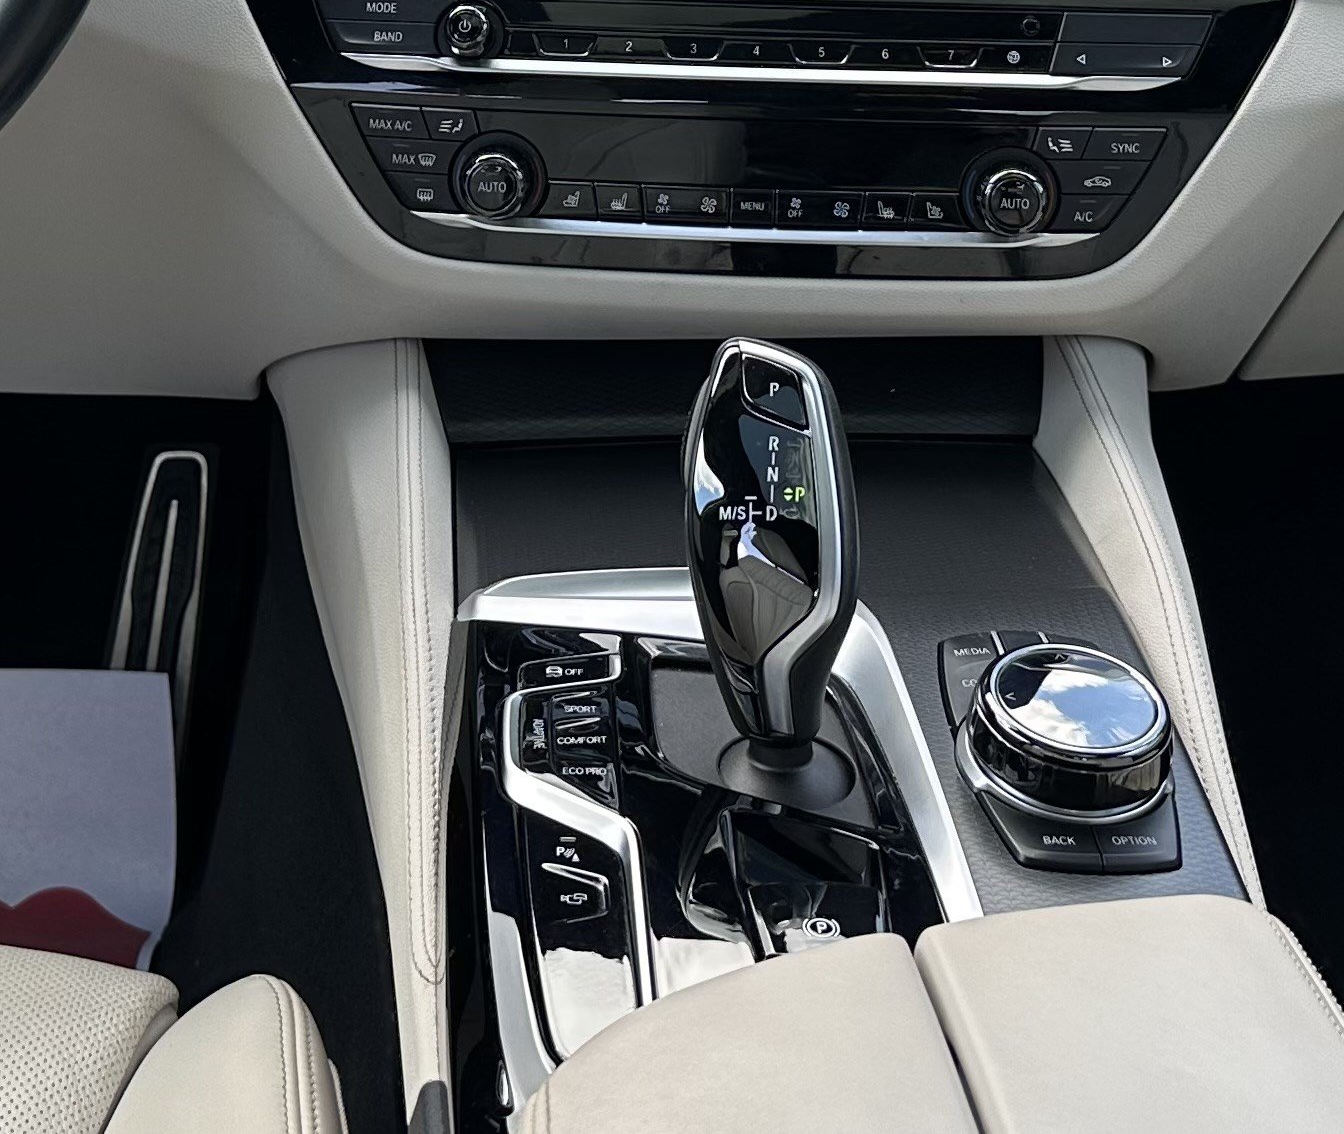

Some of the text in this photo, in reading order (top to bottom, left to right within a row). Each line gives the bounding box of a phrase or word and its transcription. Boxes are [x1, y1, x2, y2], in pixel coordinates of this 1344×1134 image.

[366, 2, 398, 14] MODE
[373, 31, 403, 43] BAND
[563, 38, 569, 50] 1
[625, 41, 633, 52] 2
[690, 43, 698, 55] 3
[752, 44, 760, 56] 4
[818, 46, 826, 58] 5
[882, 49, 889, 60] 6
[947, 50, 954, 61] 7
[369, 118, 413, 132] MAX A/C
[1110, 142, 1141, 155] SYNC
[391, 153, 416, 166] MAX
[477, 180, 507, 194] AUTO
[654, 204, 671, 214] OFF
[740, 200, 765, 212] MENU
[1000, 198, 1030, 211] AUTO
[787, 209, 803, 218] OFF
[1074, 210, 1093, 223] A/C
[769, 382, 780, 397] P
[768, 436, 779, 451] R
[767, 467, 778, 482] N
[795, 487, 805, 502] P
[718, 505, 778, 521] M/S D
[953, 646, 991, 657] MEDIA
[564, 668, 585, 676] OFF
[563, 705, 597, 713] SPORT
[556, 735, 608, 745] COMFORT
[562, 767, 607, 775] ECO PRO
[1042, 835, 1077, 846] BACK
[1111, 835, 1157, 846] OPTION
